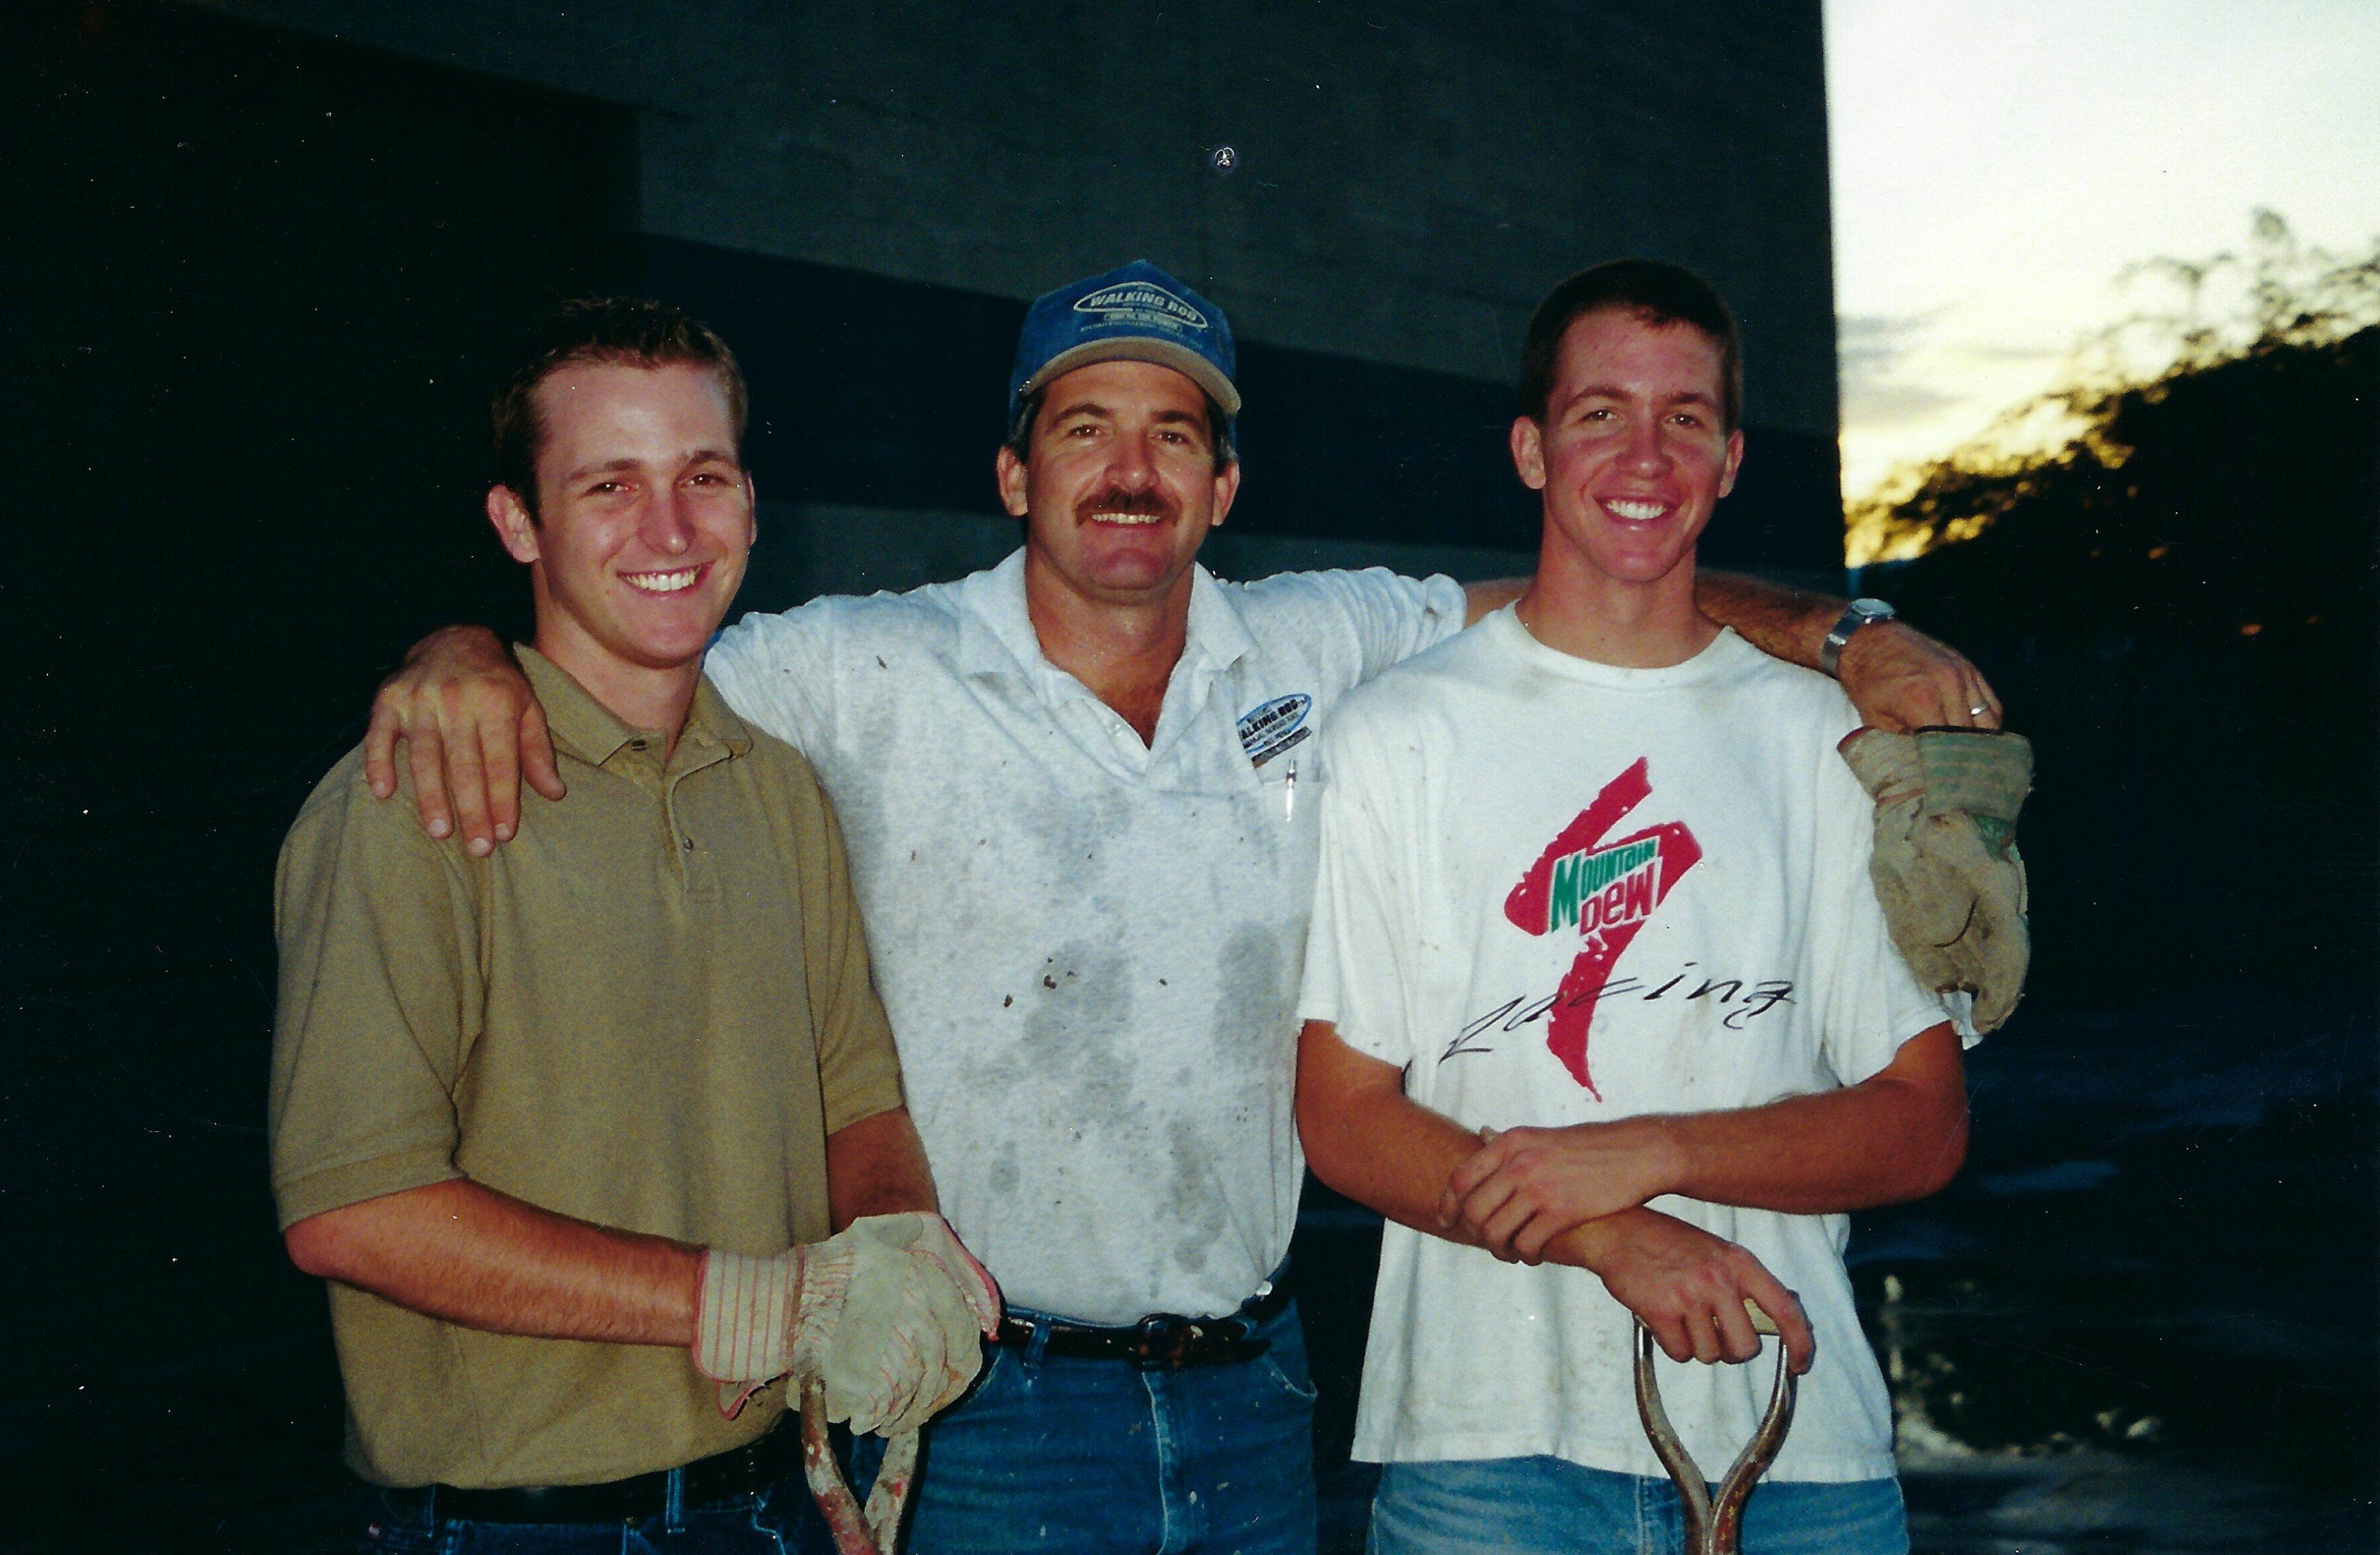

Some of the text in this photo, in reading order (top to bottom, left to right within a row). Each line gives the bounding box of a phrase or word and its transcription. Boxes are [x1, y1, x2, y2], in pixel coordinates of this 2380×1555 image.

[1090, 292, 1166, 307] WALKING
[1168, 300, 1198, 322] ROD
[1238, 710, 1278, 741] ALKING
[1277, 698, 1298, 717] ROD
